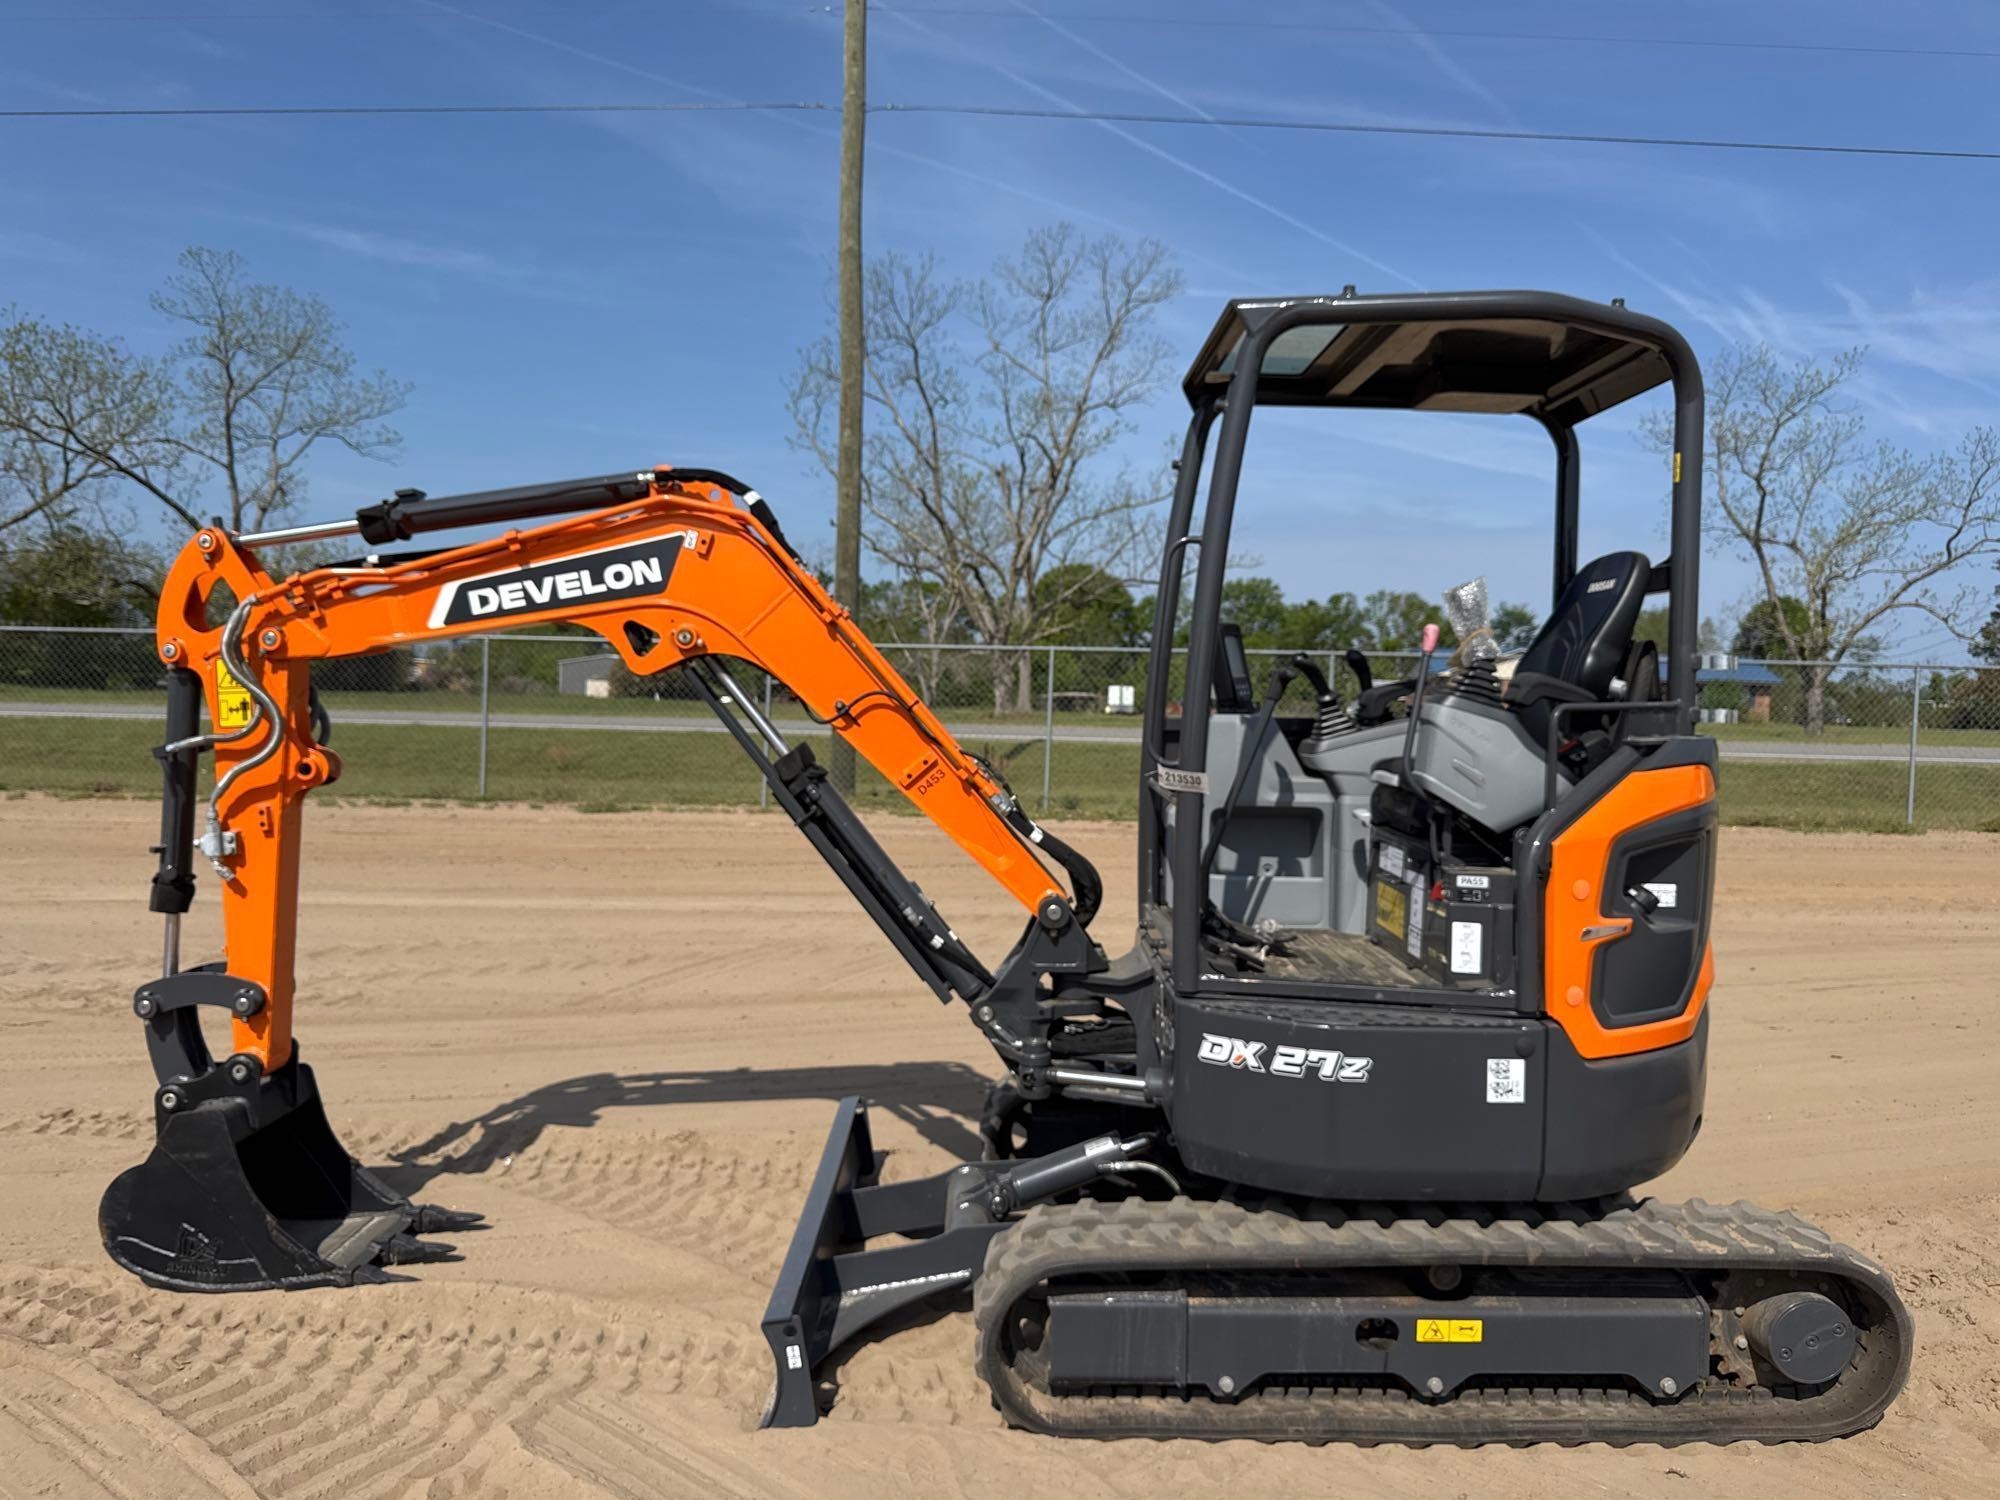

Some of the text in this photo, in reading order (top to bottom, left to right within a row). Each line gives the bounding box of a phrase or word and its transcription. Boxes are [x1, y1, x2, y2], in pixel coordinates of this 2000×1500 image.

[467, 557, 662, 616] DEVELON
[917, 769, 946, 795] D453
[1164, 772, 1201, 785] 213530
[1460, 877, 1484, 885] PASS
[1197, 1033, 1268, 1074] DX
